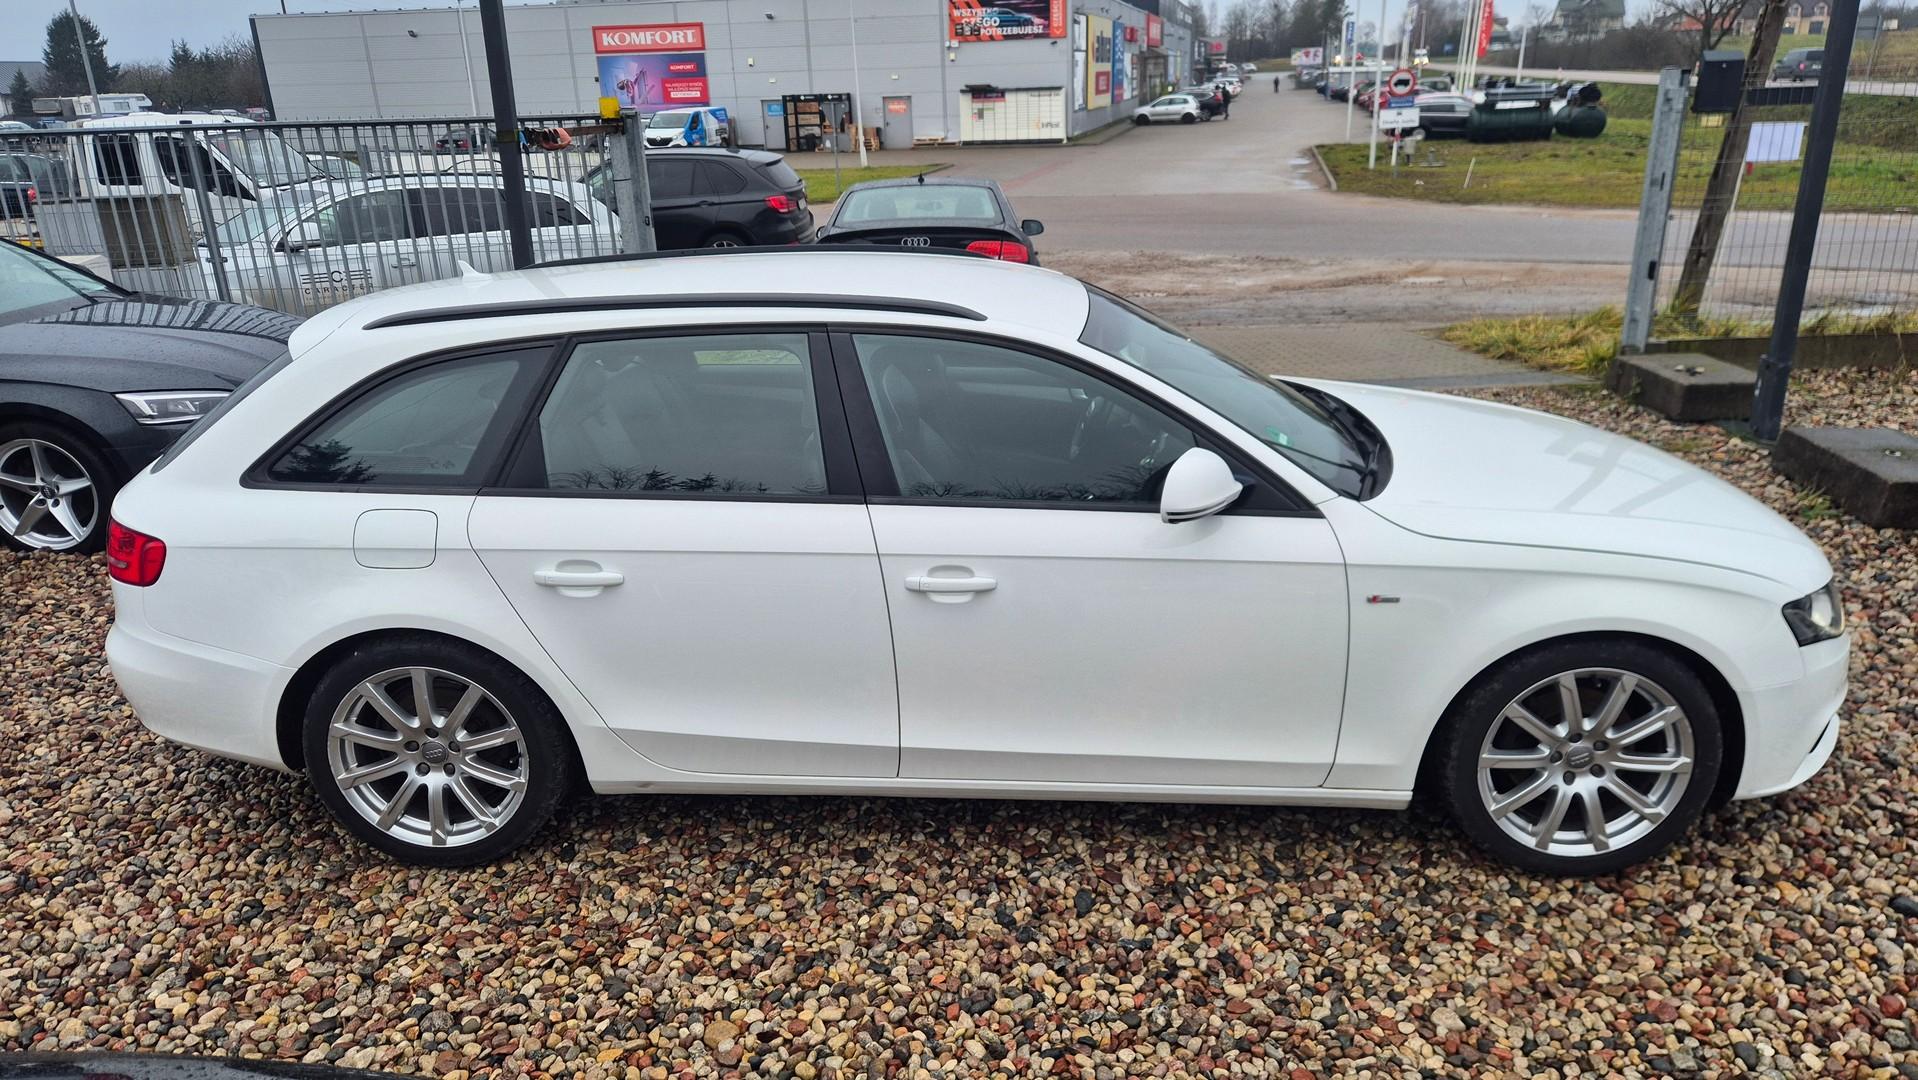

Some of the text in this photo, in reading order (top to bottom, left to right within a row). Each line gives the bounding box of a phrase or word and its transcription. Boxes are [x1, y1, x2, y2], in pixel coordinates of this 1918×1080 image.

[953, 7, 1000, 17] WSZYSTKO
[961, 16, 1000, 27] CZEGO
[979, 24, 1043, 36] POTRZEBUJESZ
[602, 29, 697, 46] KOMFORT
